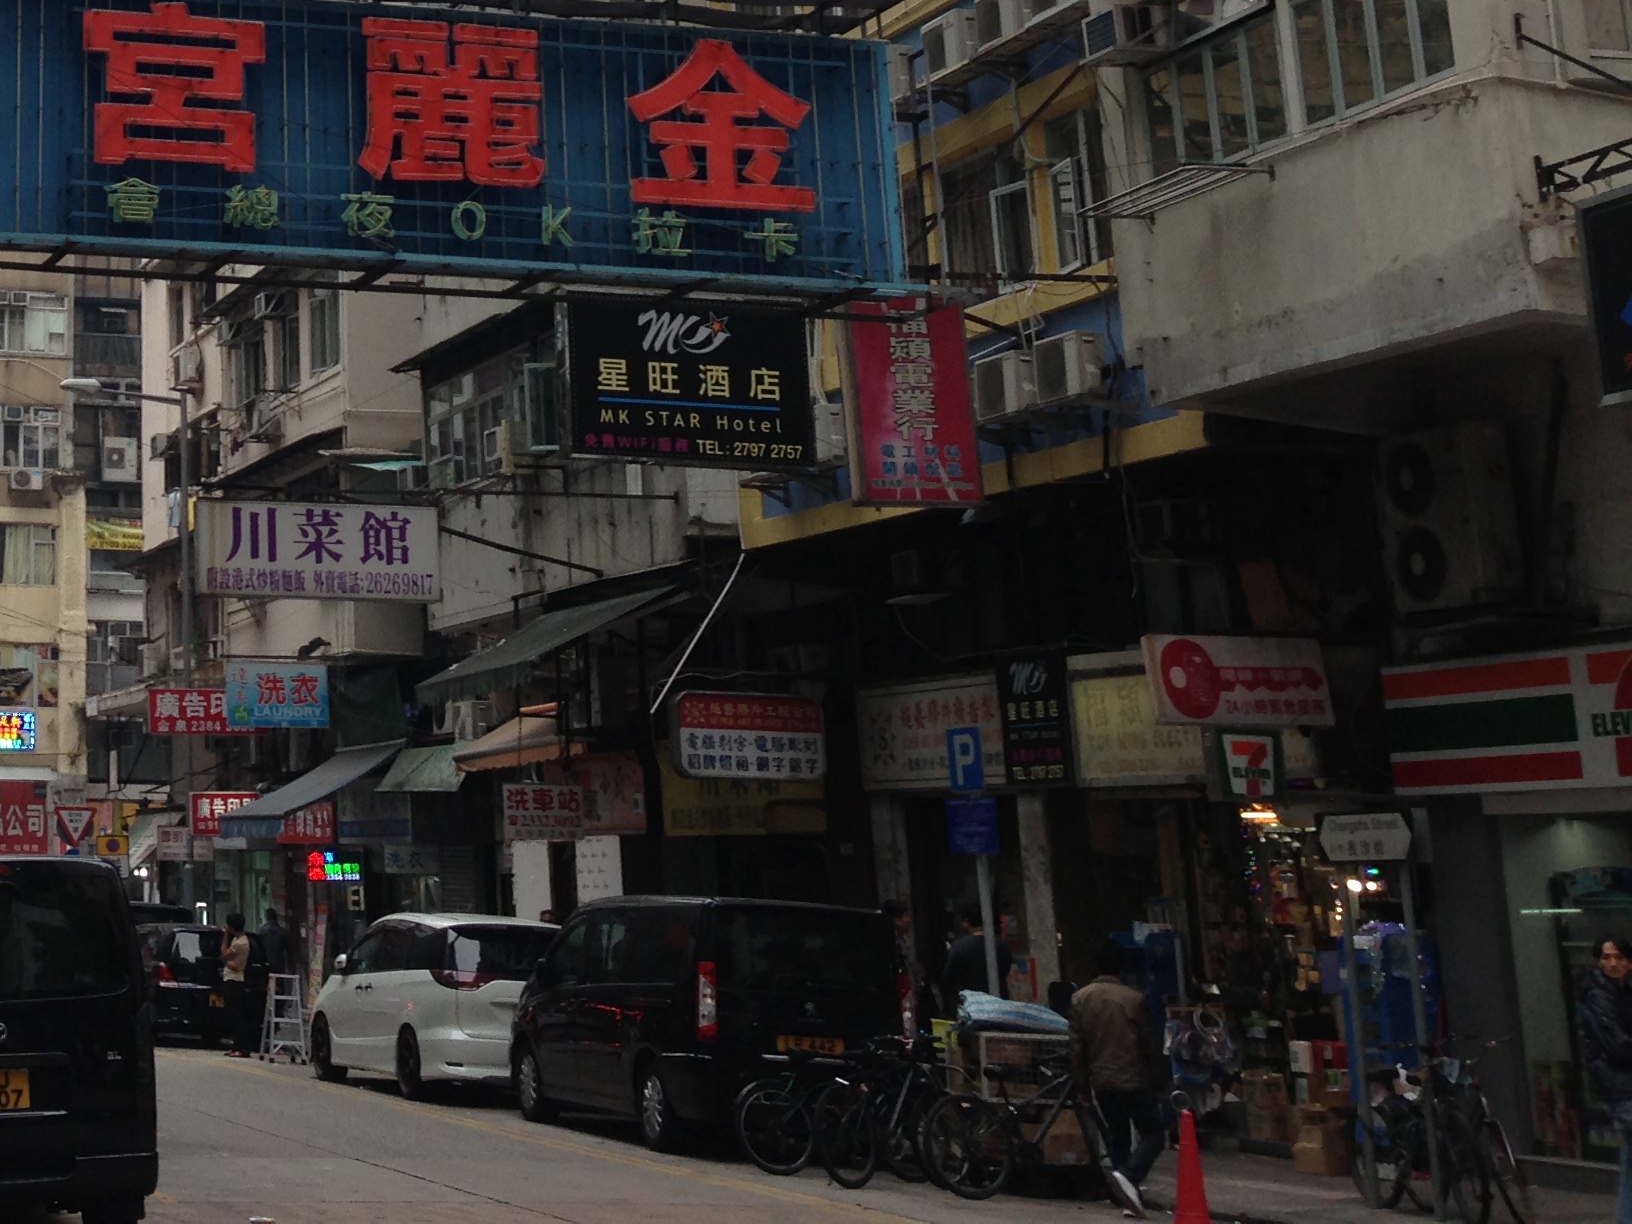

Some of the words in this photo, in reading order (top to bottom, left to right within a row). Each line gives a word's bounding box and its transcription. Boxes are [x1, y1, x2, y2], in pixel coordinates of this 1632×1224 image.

[597, 357, 781, 401] 星旺酒店
[599, 408, 631, 425] MK
[644, 409, 702, 428] STAR
[715, 414, 783, 434] Hotel
[695, 438, 731, 456] TEL:
[733, 441, 766, 458] 2797
[770, 443, 803, 460] 2757
[225, 506, 413, 567] 川菜館
[255, 671, 321, 706] 洗衣
[254, 705, 322, 719] LAUNDRY
[952, 732, 975, 787] P
[506, 787, 581, 813] 洗車站
